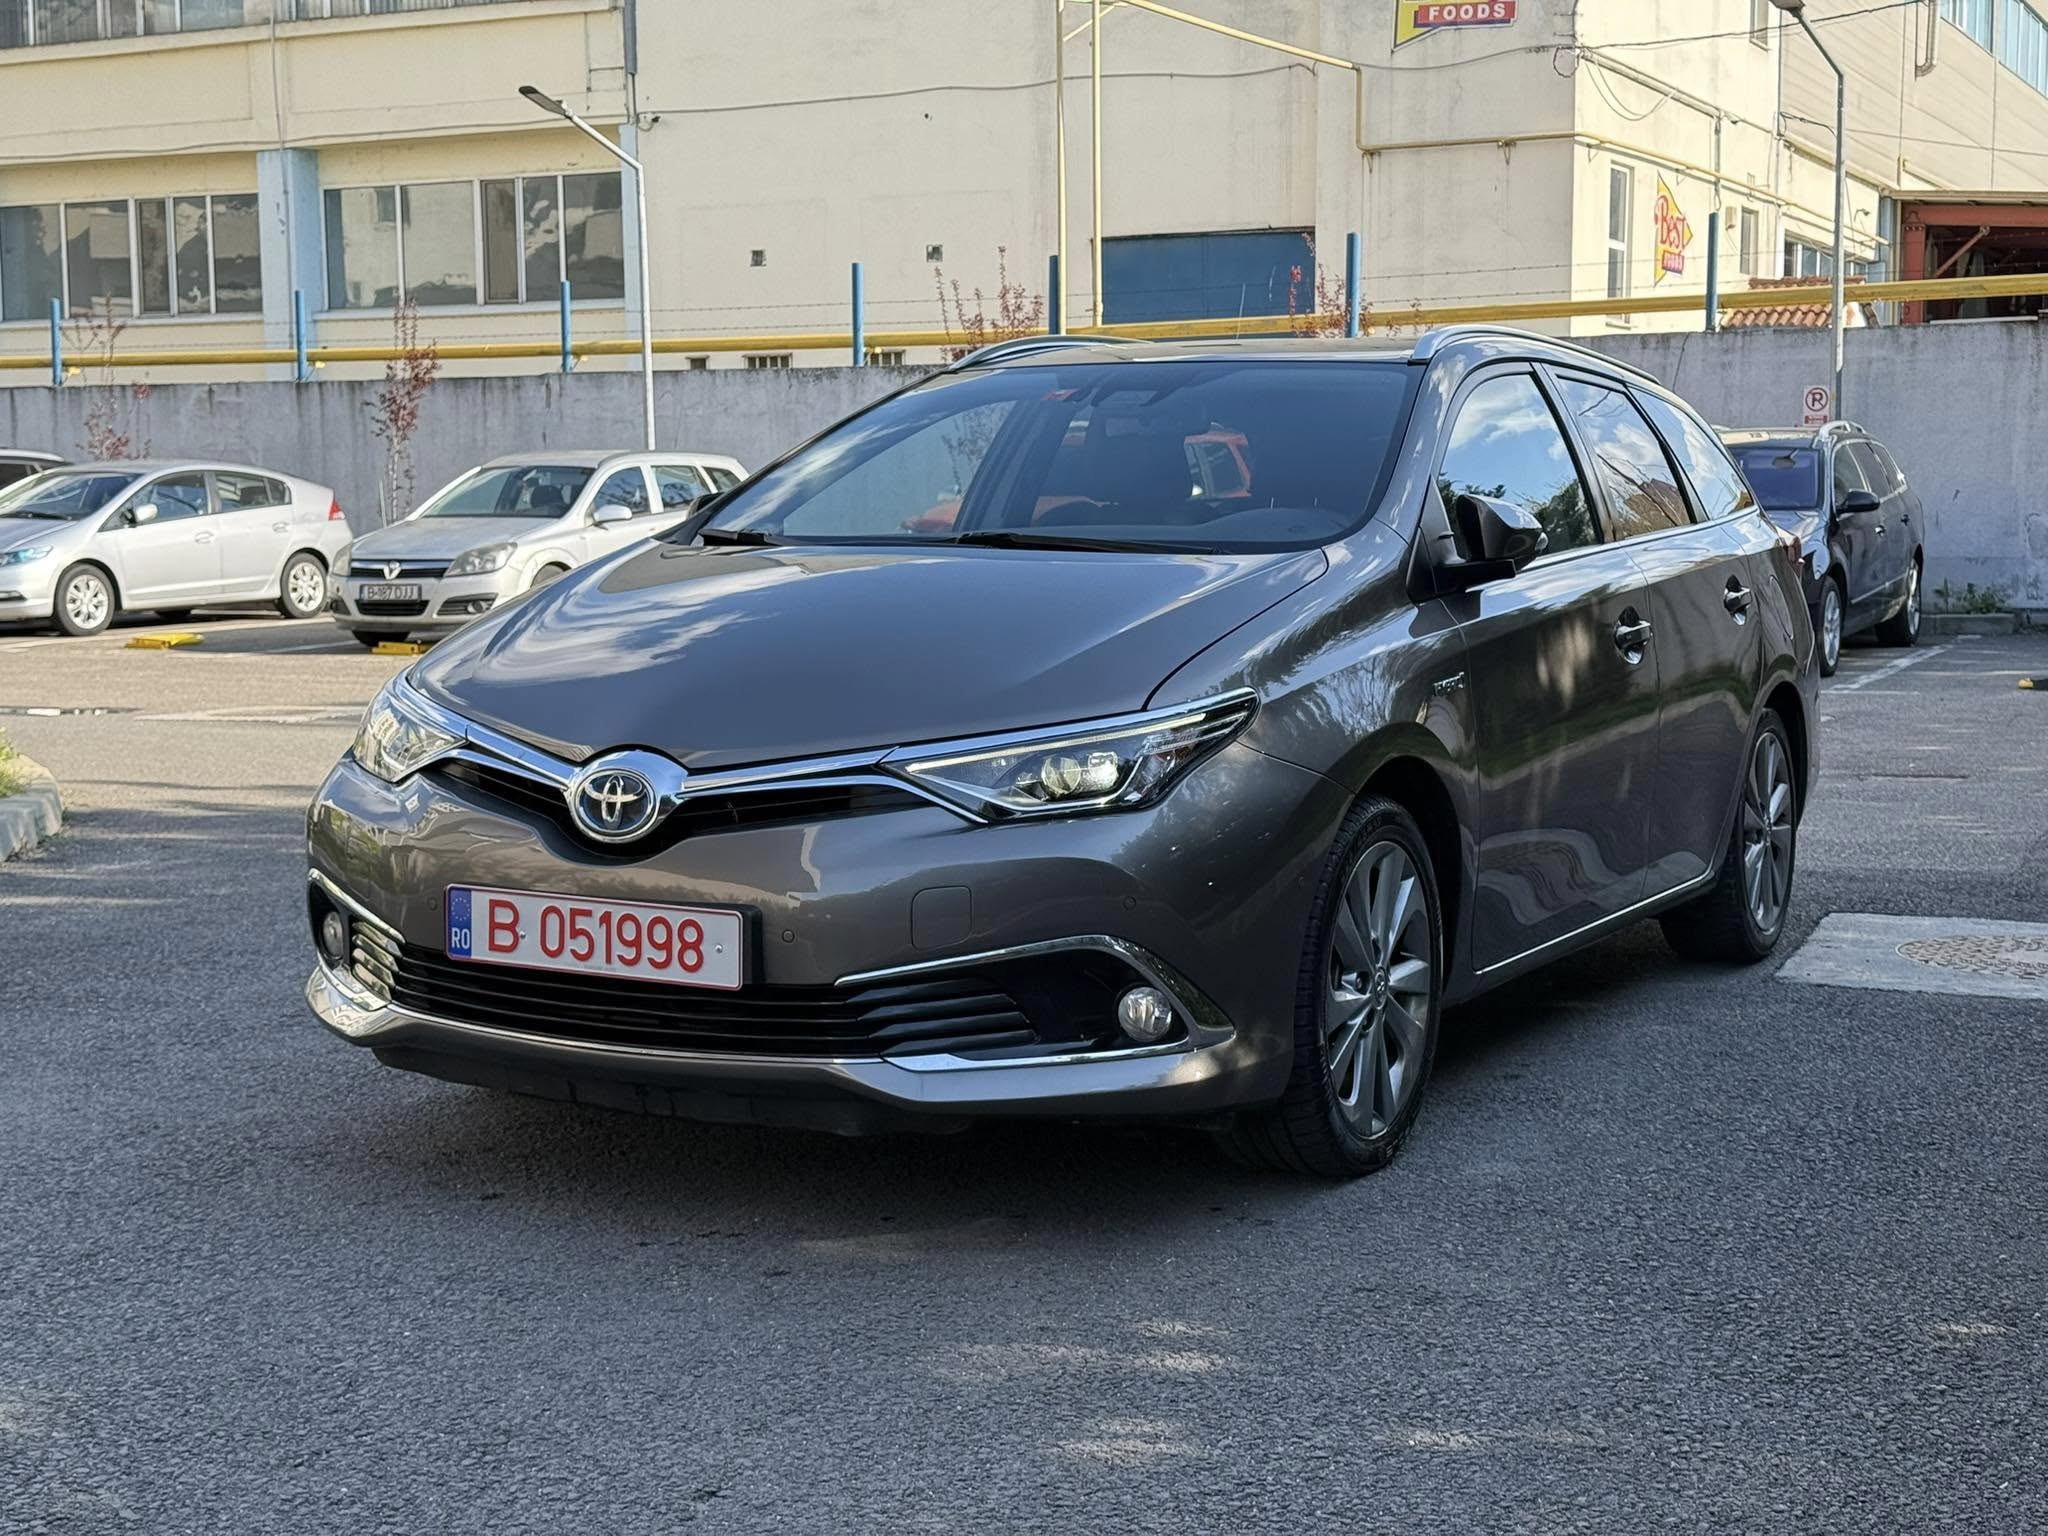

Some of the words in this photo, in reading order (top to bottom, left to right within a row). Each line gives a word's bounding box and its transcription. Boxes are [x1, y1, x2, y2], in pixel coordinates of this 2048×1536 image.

[1428, 2, 1506, 21] FOODS
[451, 927, 471, 950] RO
[488, 898, 520, 953] B
[539, 904, 704, 973] 051998
